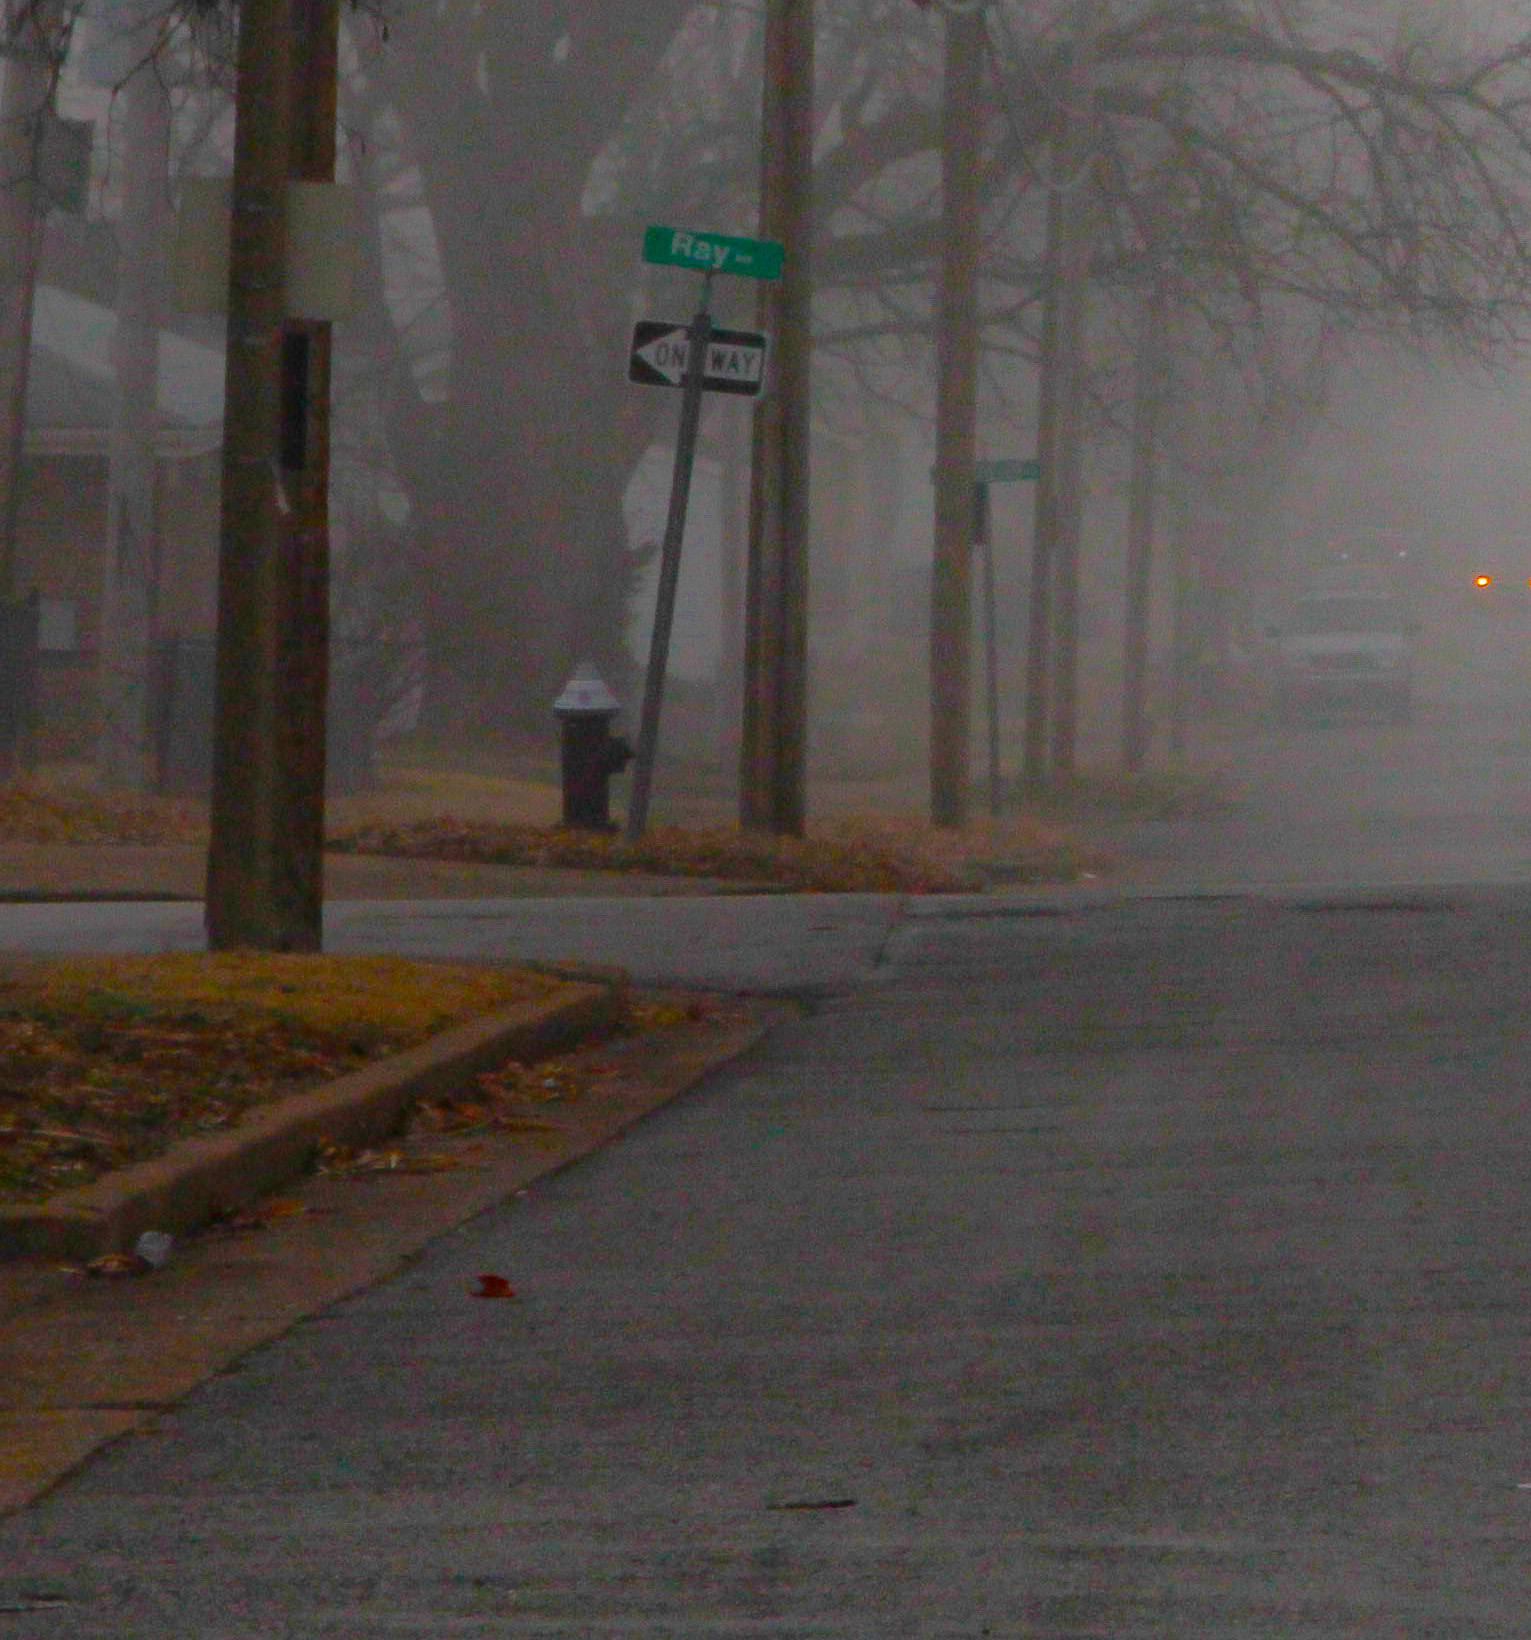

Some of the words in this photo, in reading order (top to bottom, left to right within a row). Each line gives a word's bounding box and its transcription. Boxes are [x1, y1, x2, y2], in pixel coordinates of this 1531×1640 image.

[671, 232, 730, 268] Ray
[655, 341, 687, 368] ON
[711, 348, 755, 375] WAY
